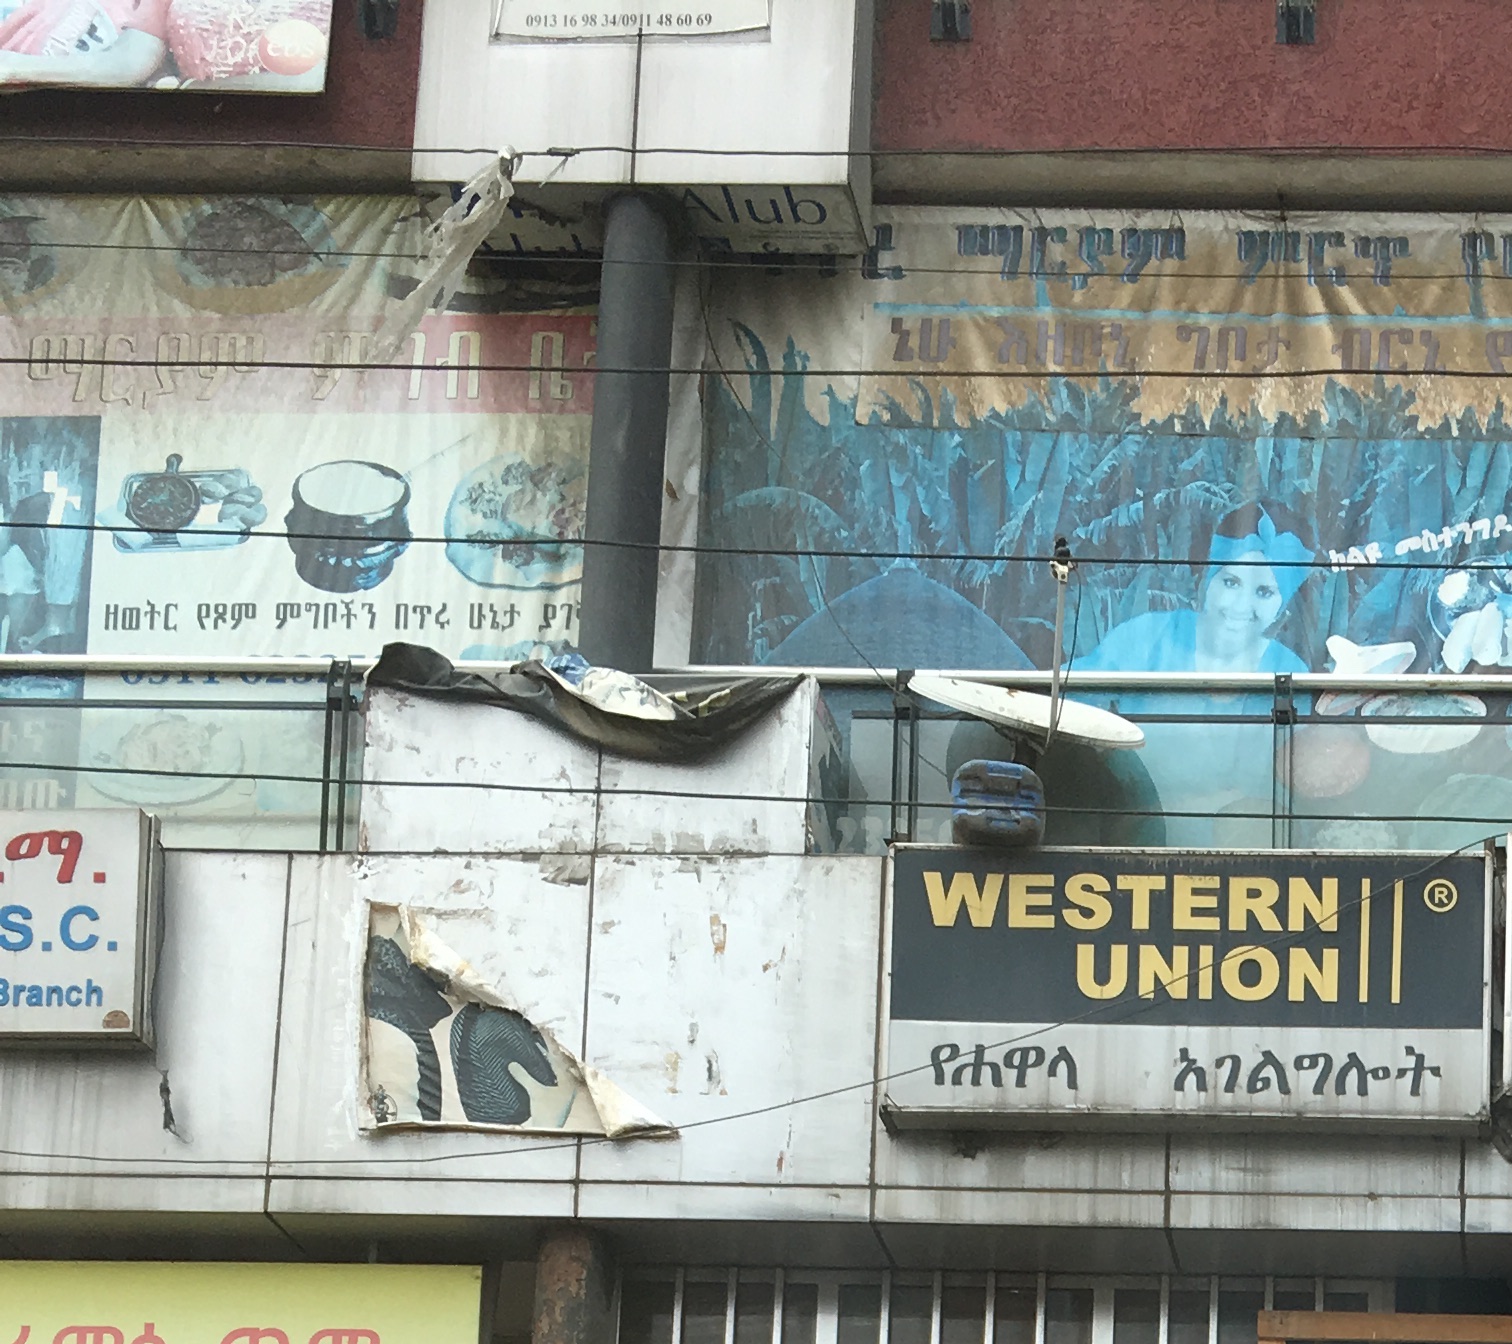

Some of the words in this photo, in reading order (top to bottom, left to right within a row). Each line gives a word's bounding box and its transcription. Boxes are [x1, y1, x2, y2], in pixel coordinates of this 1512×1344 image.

[526, 14, 557, 27] 0913
[562, 14, 577, 27] 16
[581, 14, 597, 27] 98
[656, 14, 672, 26] 48
[676, 13, 692, 26] 60
[696, 13, 713, 26] 69
[530, 331, 597, 400] ቤ
[923, 871, 1339, 932] WESTERN
[1076, 943, 1339, 1003] UNION
[931, 1043, 1079, 1090] የሐዋላ
[1173, 1045, 1441, 1097] አገልግሎት
